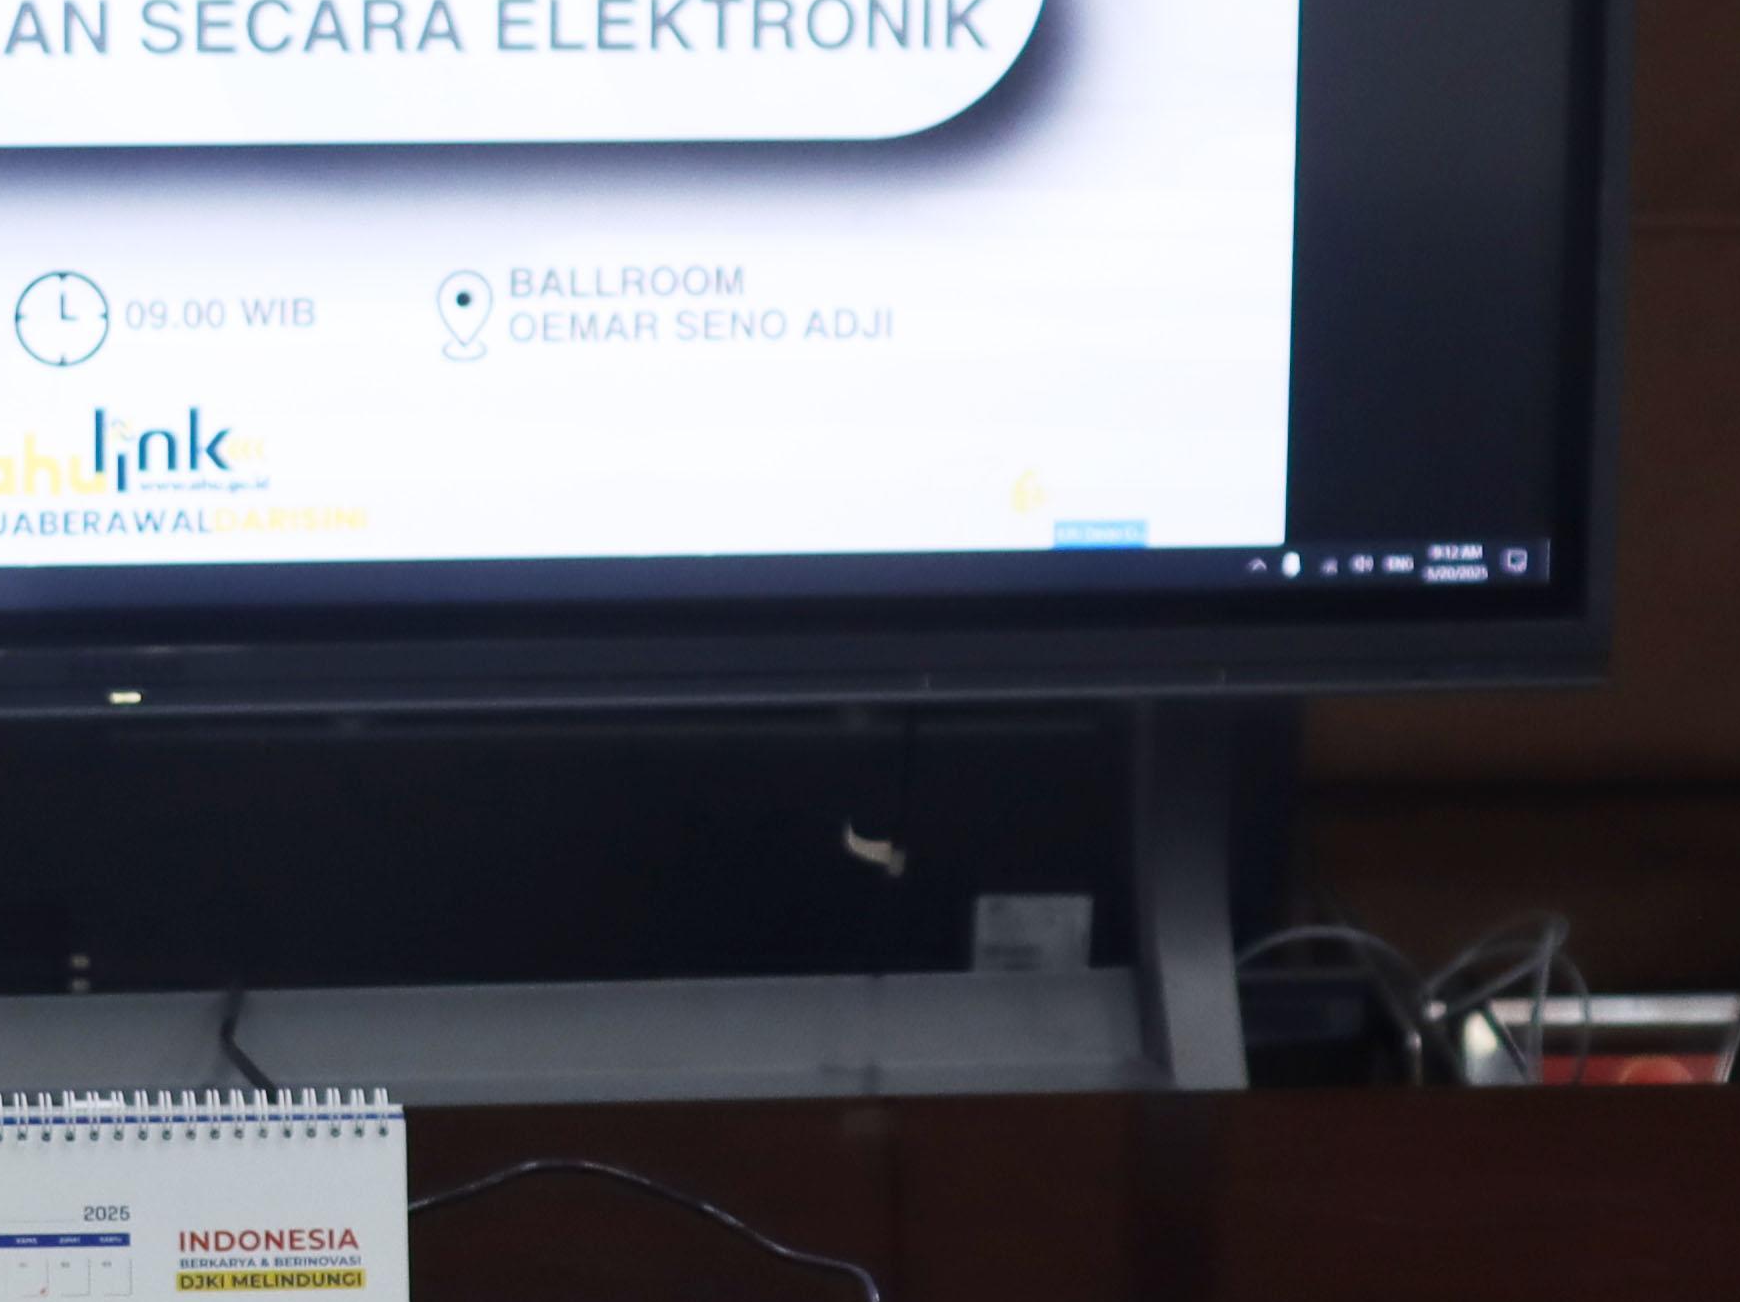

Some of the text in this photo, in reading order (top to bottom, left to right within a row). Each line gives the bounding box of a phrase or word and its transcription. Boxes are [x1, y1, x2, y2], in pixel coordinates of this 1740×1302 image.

[508, 265, 747, 301] BALLROOM
[125, 296, 318, 332] 09.00 WIB
[508, 306, 896, 344] OEMAR SENO ADJI
[83, 1205, 131, 1222] 2025
[179, 1228, 360, 1253] INDONESIA
[180, 1256, 362, 1270] BERKARYA & BERINOVASI
[180, 1272, 362, 1291] DJKI MELINDUNGI
